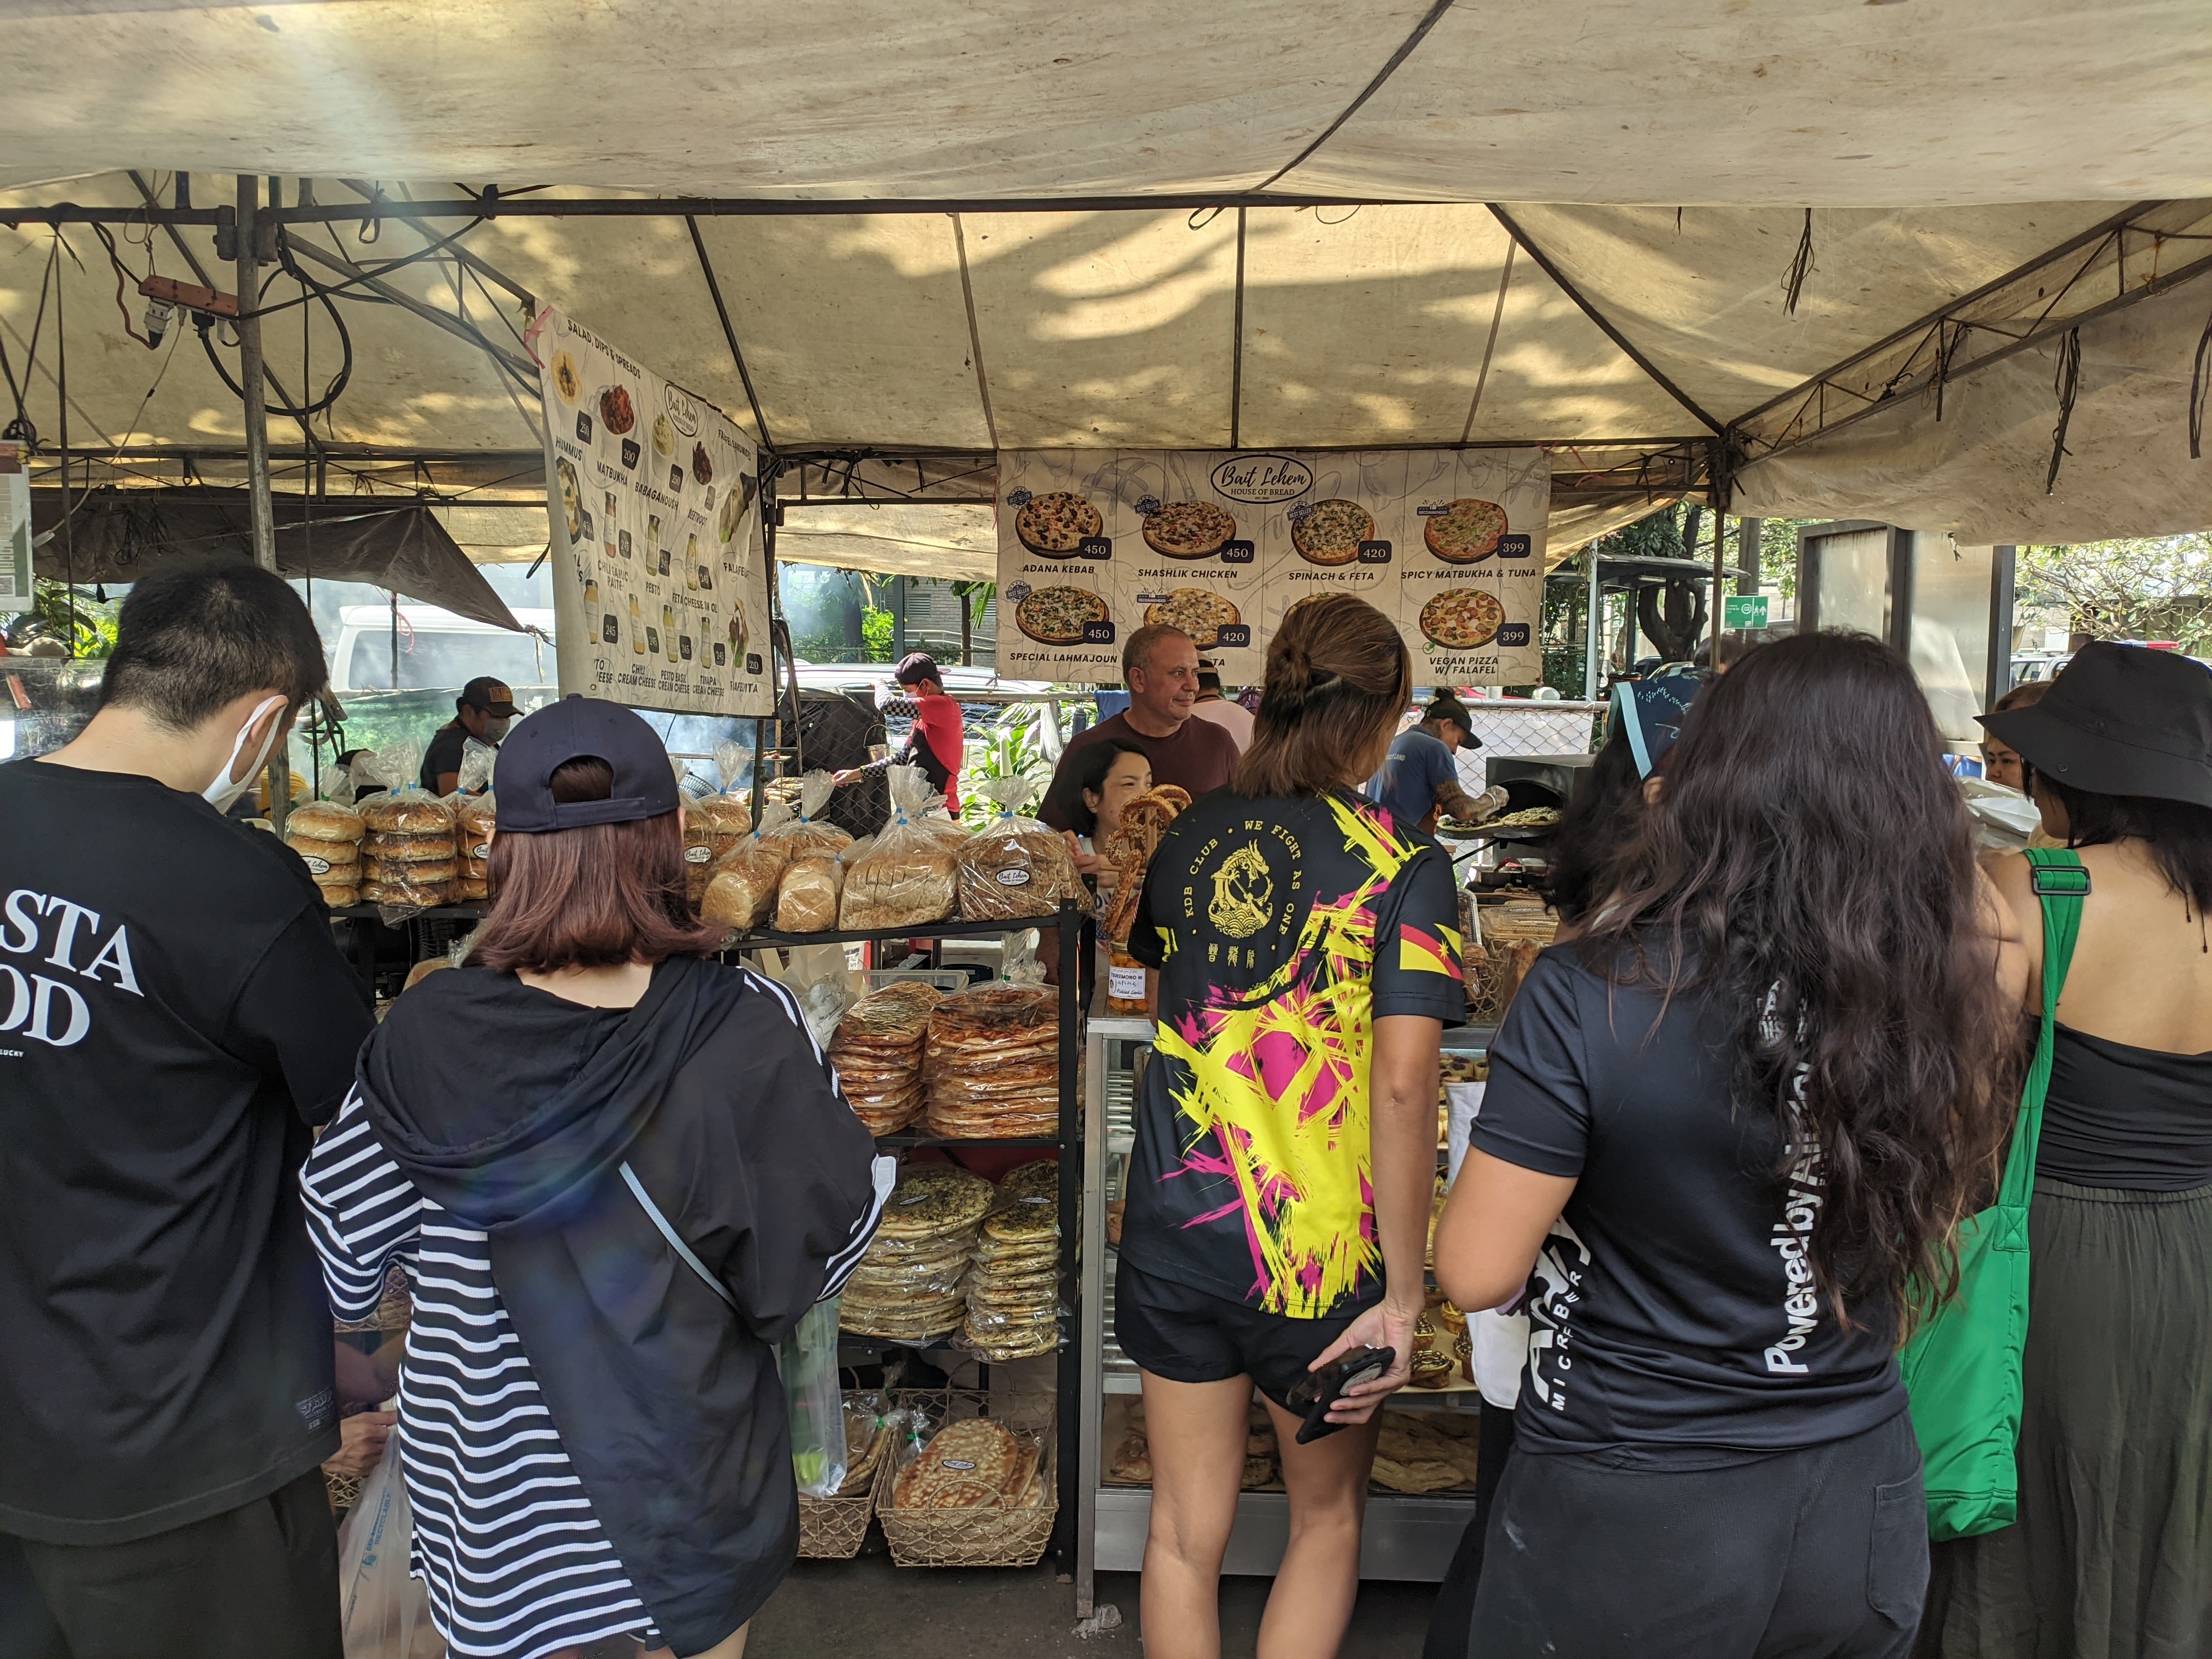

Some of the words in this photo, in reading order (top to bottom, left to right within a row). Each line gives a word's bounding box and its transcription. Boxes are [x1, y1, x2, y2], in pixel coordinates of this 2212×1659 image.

[567, 319, 593, 347] SALAD,
[594, 337, 609, 357] DIPS
[556, 435, 582, 461] HUMMUS
[624, 448, 635, 463] 200
[597, 461, 628, 487] MATBUKHA
[671, 473, 681, 486] 250
[1220, 466, 1258, 488] Bait
[1261, 461, 1307, 486] Lehem
[635, 481, 679, 512] BABAGANOUSH
[583, 520, 592, 534] 450
[620, 540, 629, 552] 245
[1084, 545, 1107, 555] 450
[1503, 542, 1525, 553] 399
[1227, 547, 1249, 558] 450
[1363, 549, 1386, 559] 420
[1022, 565, 1059, 573] ADANA
[1062, 565, 1095, 574] KEBAB
[1138, 568, 1188, 578] SHASHLIK
[1191, 570, 1238, 579] CHICKEN
[1401, 570, 1433, 580] SPICY
[1435, 570, 1494, 579] MATBUKHA
[1496, 570, 1504, 578] &
[1507, 569, 1537, 578] TUNA
[1288, 572, 1335, 581] SPINACH
[1349, 572, 1375, 581] FETA
[646, 581, 660, 596] PESTO
[1016, 587, 1030, 595] SELLER
[672, 592, 684, 604] FETA
[684, 596, 704, 609] CHEESE
[606, 624, 616, 637] 245
[1088, 629, 1110, 639] 450
[1503, 631, 1525, 641] 399
[649, 636, 658, 647] 245
[1223, 632, 1245, 642] 420
[716, 651, 724, 660] 245
[1010, 653, 1051, 662] SPECIAL
[1054, 654, 1118, 664] LAHMAJOUN
[1429, 656, 1466, 665] VEGAN
[1468, 656, 1499, 665] PIZZA
[1209, 658, 1225, 666] TA
[632, 664, 645, 675] CHILI
[1435, 665, 1449, 676] W/
[1453, 665, 1496, 674] FALAFEL
[597, 671, 613, 684] EESE
[618, 672, 638, 685] CREAM
[638, 676, 656, 688] CHEESE
[661, 670, 674, 681] PESTO
[658, 680, 673, 691] CREAM
[1244, 820, 1264, 831] WE
[1271, 824, 1302, 861] FIGHT
[998, 872, 1011, 880] Bait
[1012, 870, 1028, 879] Lehem
[1183, 886, 1194, 919] KDB
[1190, 838, 1219, 875] CLUB
[1292, 869, 1302, 891] AS
[1279, 902, 1296, 936] ONE
[1772, 1188, 1824, 1233] by
[1764, 1237, 1818, 1374] Powered
